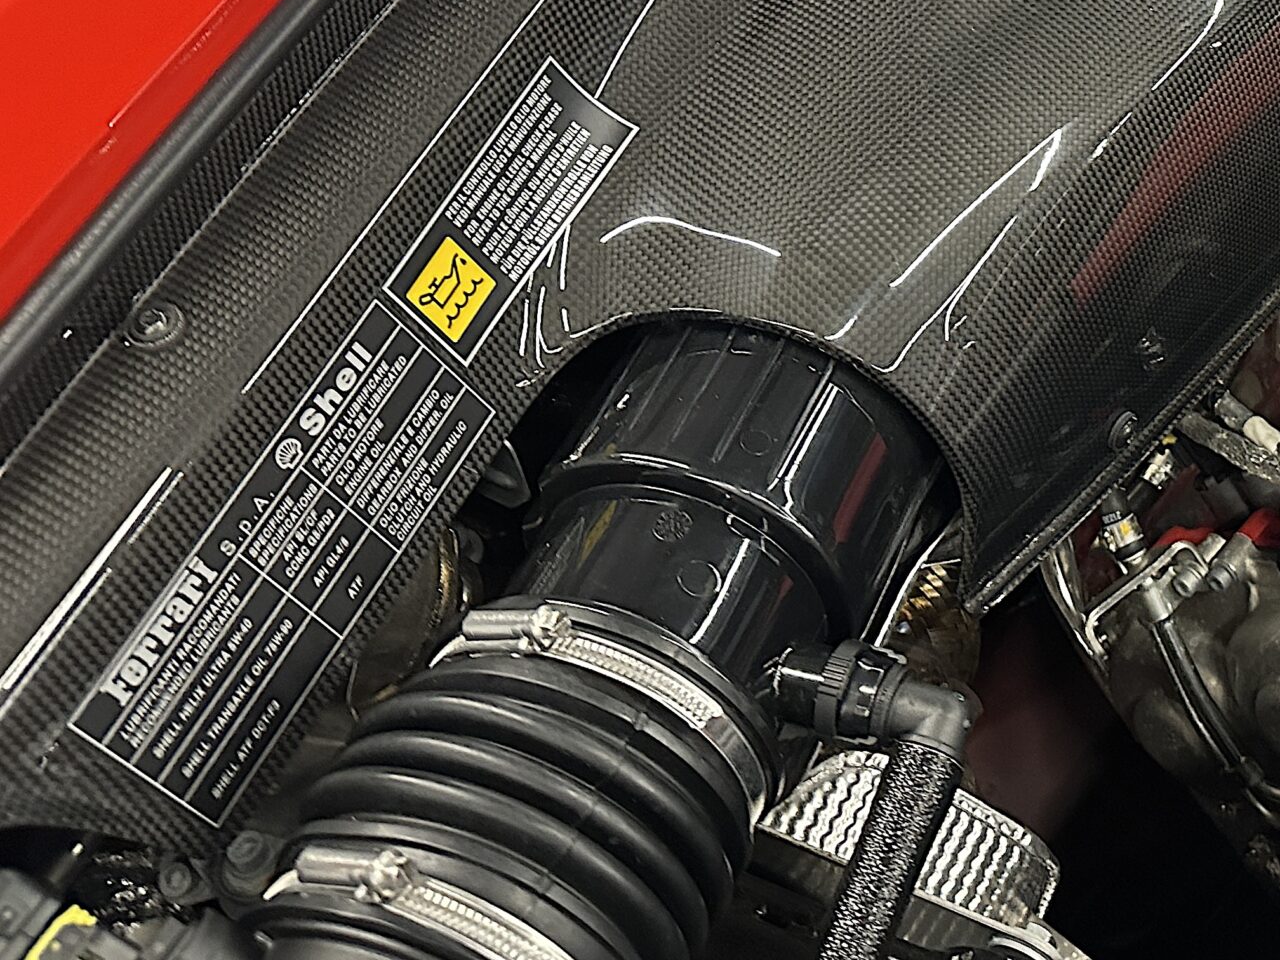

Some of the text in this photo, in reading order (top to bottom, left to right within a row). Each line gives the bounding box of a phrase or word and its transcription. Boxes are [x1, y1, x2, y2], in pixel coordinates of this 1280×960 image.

[444, 74, 552, 221] PER IL CONTROLLO LIVELLO OLIO MOTORE
[491, 154, 508, 174] USO
[503, 147, 513, 158] E
[507, 92, 552, 152] MANUTENZIONE
[463, 102, 563, 239] FOR ENGINE OIL LEVEL CHECK PLEASE
[465, 169, 497, 211] MANUALE
[471, 129, 558, 247] REFER TO THE OWNER'S MANUAL
[481, 231, 503, 257] POUR
[496, 221, 510, 235] LE
[527, 175, 541, 191] DU
[535, 148, 561, 180] NIVEAU
[554, 120, 582, 153] D'HUILE
[489, 127, 593, 265] MOTEUR VOIR LA NOTICE D'ENTRETIEN
[499, 254, 517, 275] FÜR
[510, 240, 529, 259] DIE
[579, 141, 599, 163] VON
[506, 238, 541, 283] MOTORÖL
[534, 218, 559, 246] SIEHE
[299, 341, 373, 436] Shell
[311, 359, 390, 469] PARTI DA LUBRIFICARE
[320, 355, 407, 477] PARTS TO BE LUBRICATED
[335, 417, 384, 486] OLIO MOTORE
[343, 440, 386, 496] ENGINE OIL
[356, 389, 440, 509] DIFFERENZIALE E CAMBIO
[367, 466, 403, 516] GEARBOX
[401, 443, 418, 468] AND
[439, 392, 454, 410] OIL
[379, 457, 429, 528] OLIO FRIZIONE
[387, 420, 467, 536] CLUTCH AND HYDRAULIC
[248, 495, 295, 559] SPECIFICHE
[257, 482, 318, 567] SPECIFICATIONS
[282, 539, 299, 562] API
[396, 484, 438, 542] CIRCUIT OIL
[176, 572, 241, 661] RACCOMANDATI
[313, 565, 330, 588] API
[347, 575, 363, 600] ATF
[97, 555, 219, 707] Ferrari
[189, 594, 241, 663] LUBRICANTS
[152, 721, 183, 759] SHELL
[178, 685, 206, 722] HELIX
[201, 650, 232, 688] ULTRA
[182, 741, 211, 778] SHELL
[207, 674, 255, 740] TRANSAXLE
[251, 657, 269, 676] OIL
[212, 763, 238, 798] SHELL
[237, 738, 252, 762] ATF
